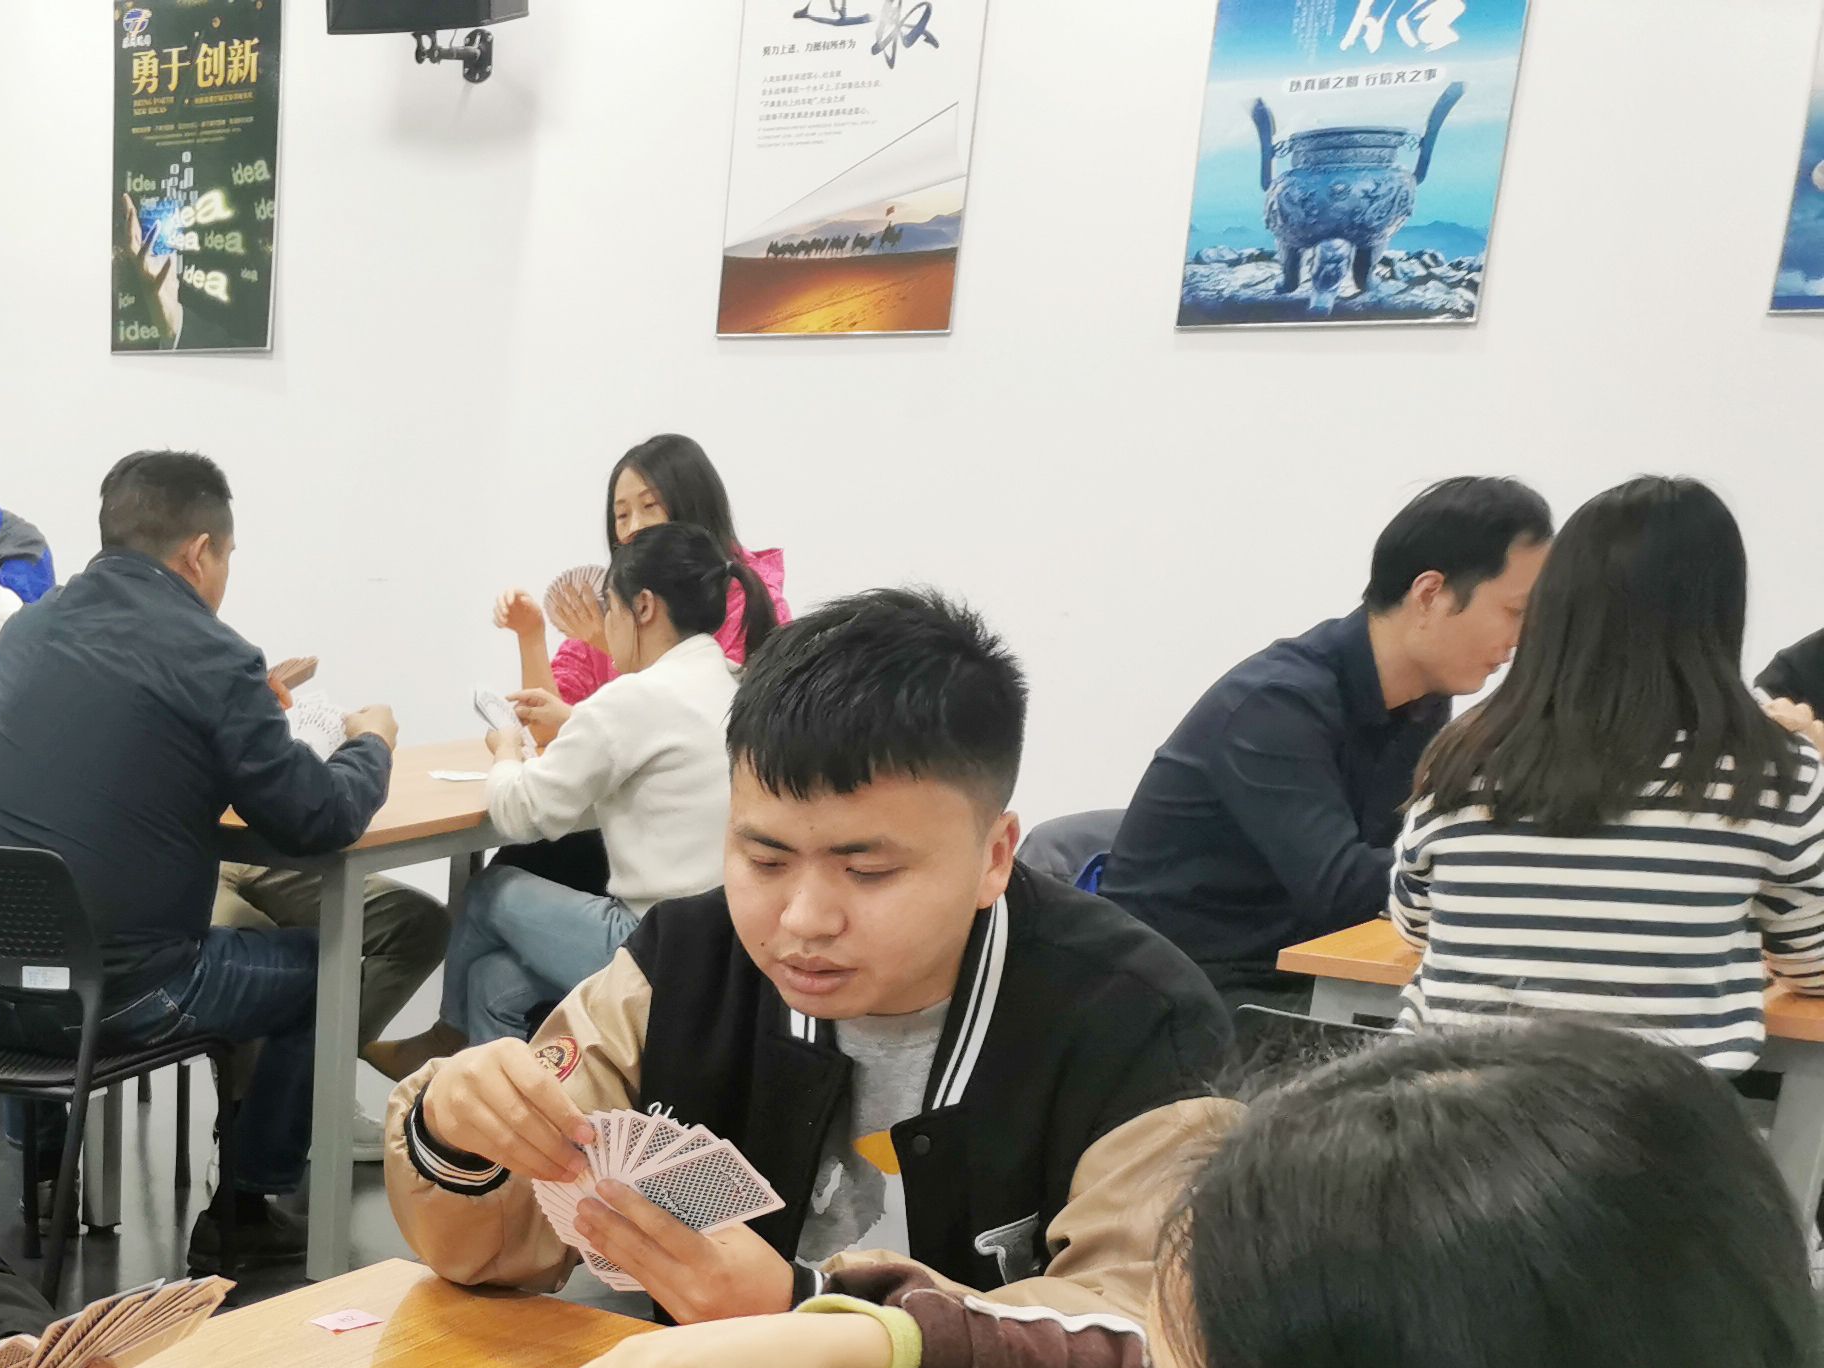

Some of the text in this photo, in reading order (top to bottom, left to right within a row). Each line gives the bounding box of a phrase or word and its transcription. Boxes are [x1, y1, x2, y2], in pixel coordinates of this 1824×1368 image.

[131, 38, 260, 96] 勇于创新
[231, 158, 270, 185] idea
[204, 229, 244, 253] idea
[182, 263, 230, 302] idea
[119, 320, 160, 341] idea
